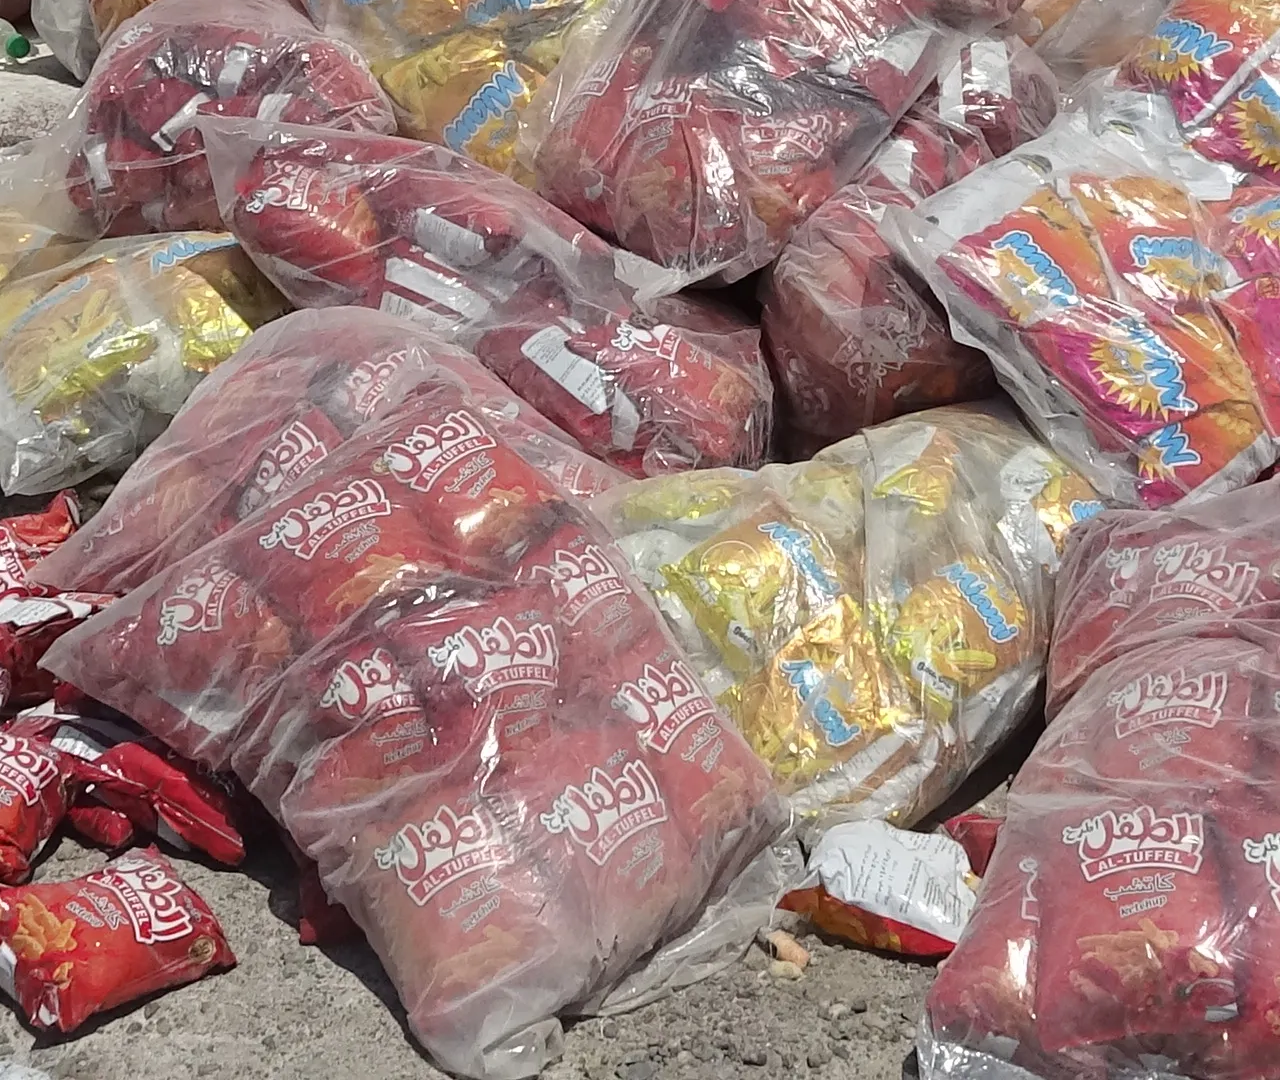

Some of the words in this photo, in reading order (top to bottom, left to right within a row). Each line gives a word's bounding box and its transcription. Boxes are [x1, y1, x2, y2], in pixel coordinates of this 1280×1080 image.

[993, 231, 1078, 306] Miami
[422, 436, 483, 482] AL-TUFFEL
[282, 478, 387, 550] الطفل
[307, 505, 375, 548] AL-TUFFEL
[571, 579, 622, 616] AL-TUFFEL
[936, 562, 1018, 641] Miami
[1159, 583, 1224, 606] AL-TUFFEL
[455, 617, 558, 678] الطفل
[482, 667, 548, 690] AL-TUFFEL
[621, 661, 706, 730] الطفل
[660, 701, 706, 742] AL-TUFFEL
[1128, 708, 1202, 731] AL-TUFFEL
[568, 759, 660, 844] الطفل
[598, 807, 657, 852] AL-TUFFEL
[1081, 806, 1204, 858] الطفل
[1097, 850, 1183, 873] AL-TUFFEL
[1103, 873, 1177, 899] كاتشب
[1120, 894, 1168, 918] Ketchup
